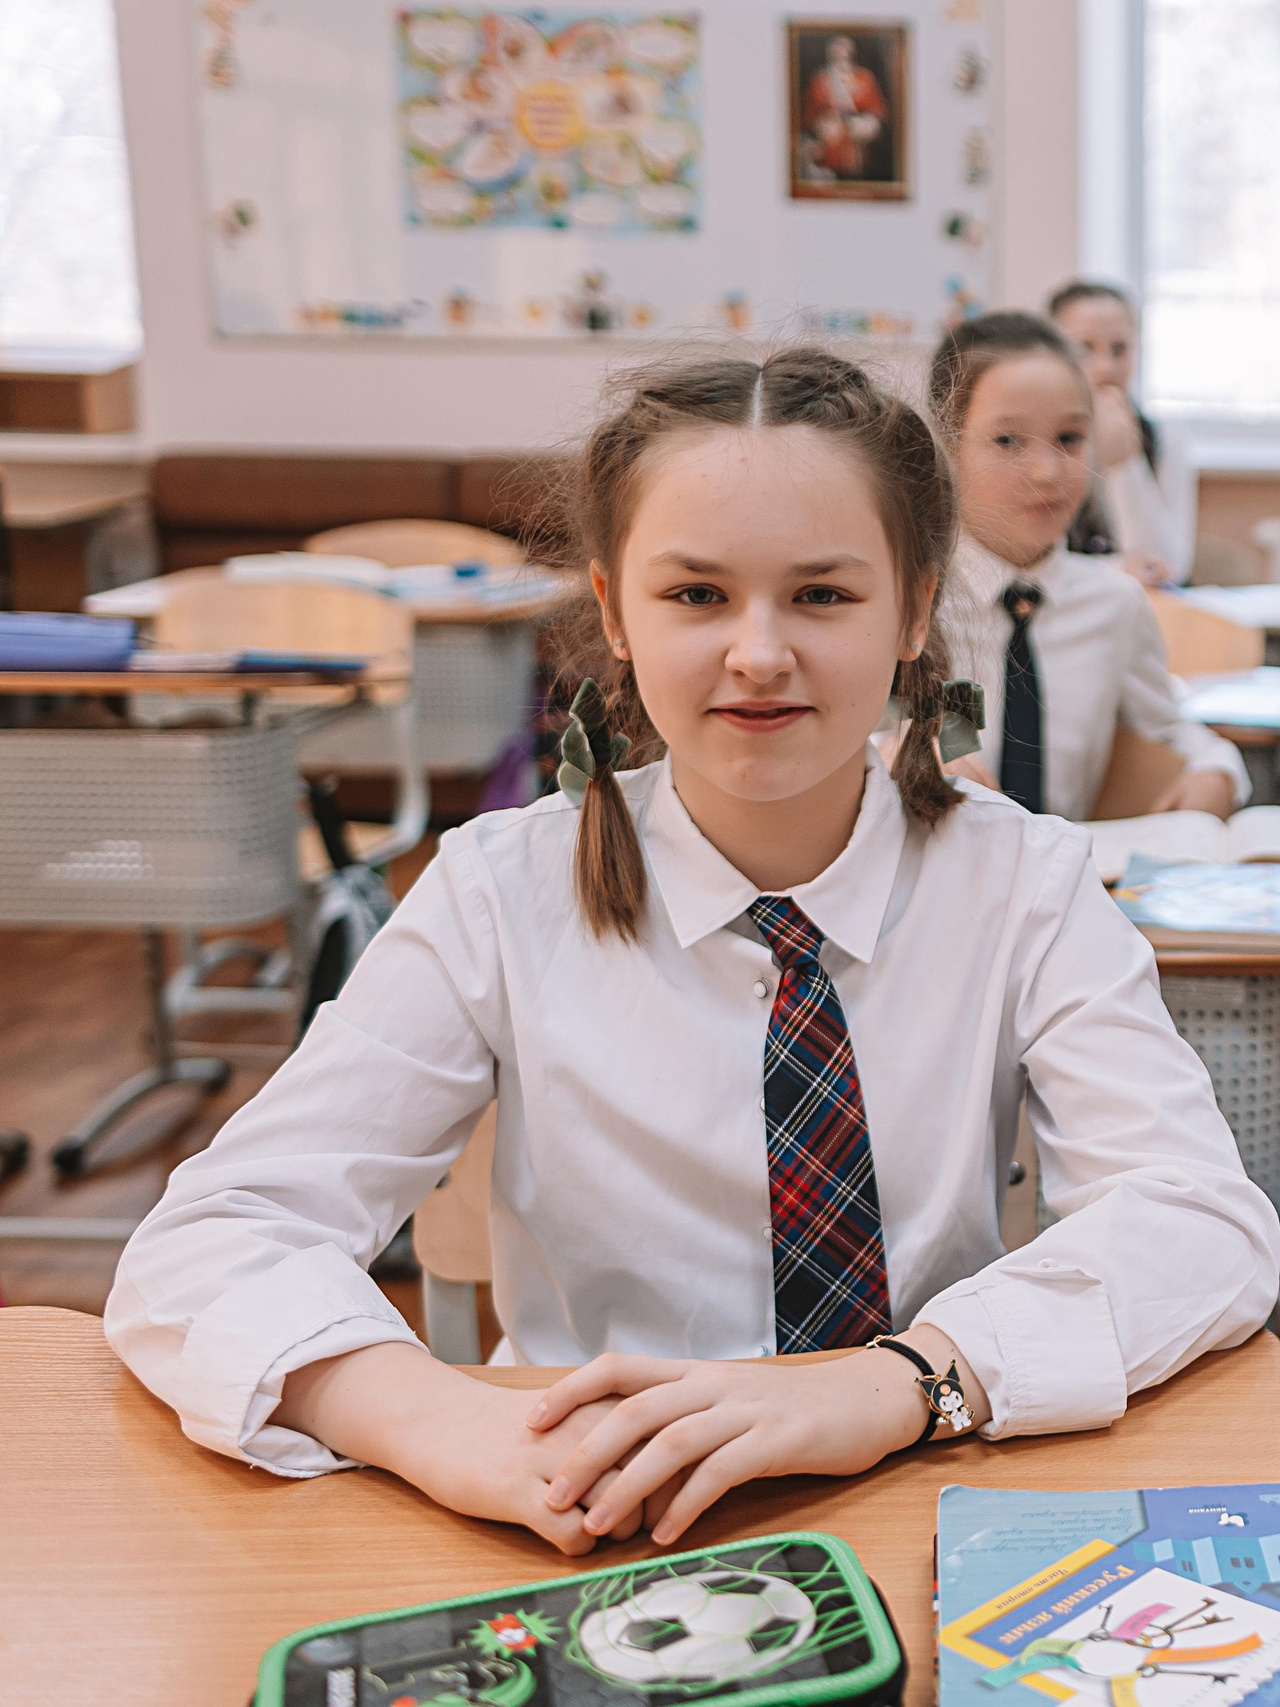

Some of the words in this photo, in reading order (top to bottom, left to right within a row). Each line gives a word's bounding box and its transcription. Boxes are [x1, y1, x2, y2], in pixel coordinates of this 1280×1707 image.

[1036, 1568, 1069, 1591] Часть
[1052, 1563, 1136, 1616] Русский
[995, 1582, 1037, 1610] вторая
[999, 1612, 1052, 1646] язык
